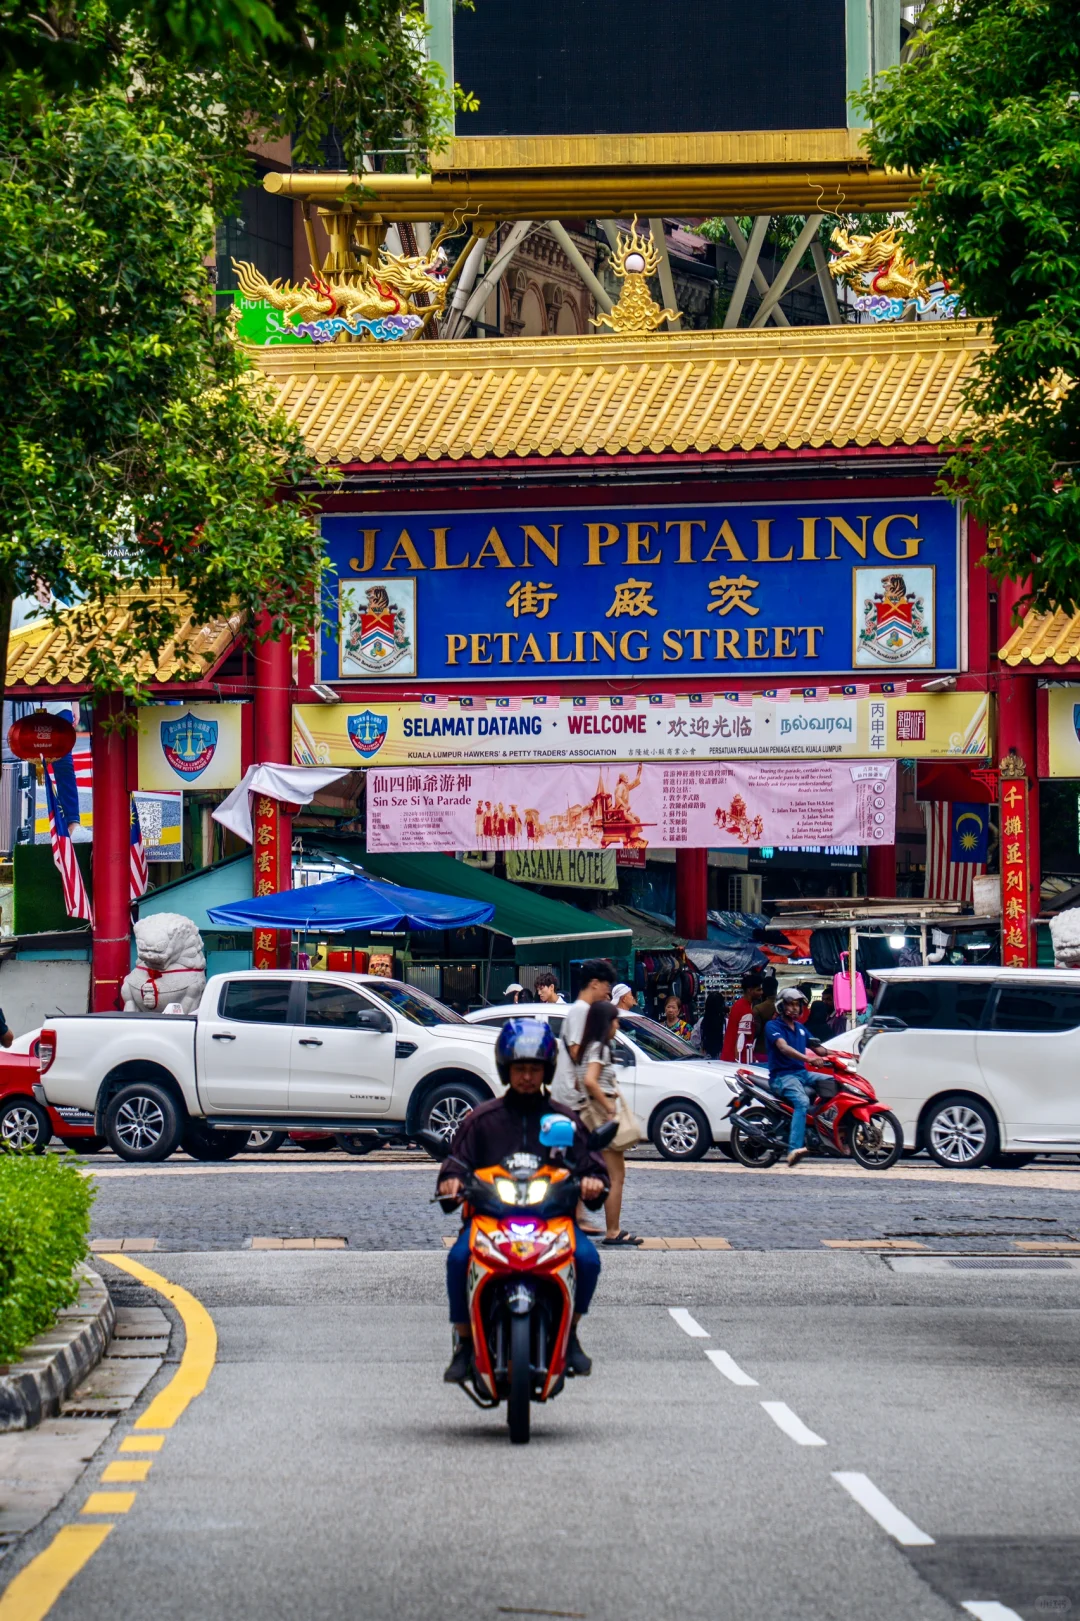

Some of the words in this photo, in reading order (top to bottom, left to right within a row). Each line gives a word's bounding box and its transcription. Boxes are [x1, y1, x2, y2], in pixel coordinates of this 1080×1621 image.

[240, 297, 275, 310] HOTE
[349, 523, 563, 572] JALAN
[583, 513, 923, 566] PETALING
[445, 629, 650, 665] PETALING
[662, 626, 824, 661] STREET
[403, 717, 475, 737] SELAMAT
[477, 716, 542, 736] DATANG
[567, 714, 647, 734] WELCOME
[667, 715, 752, 738] 欢迎光临
[871, 703, 885, 750] 丙申年
[738, 746, 759, 754] PENJAJA
[822, 745, 842, 753] LUMPUR
[373, 774, 472, 793] 仙四師爺游神
[373, 797, 388, 807] Sin
[391, 796, 408, 806] Sze
[411, 796, 420, 806] Si
[423, 796, 434, 806] Ya
[437, 795, 472, 805] Parade
[568, 849, 607, 884] HOTEL
